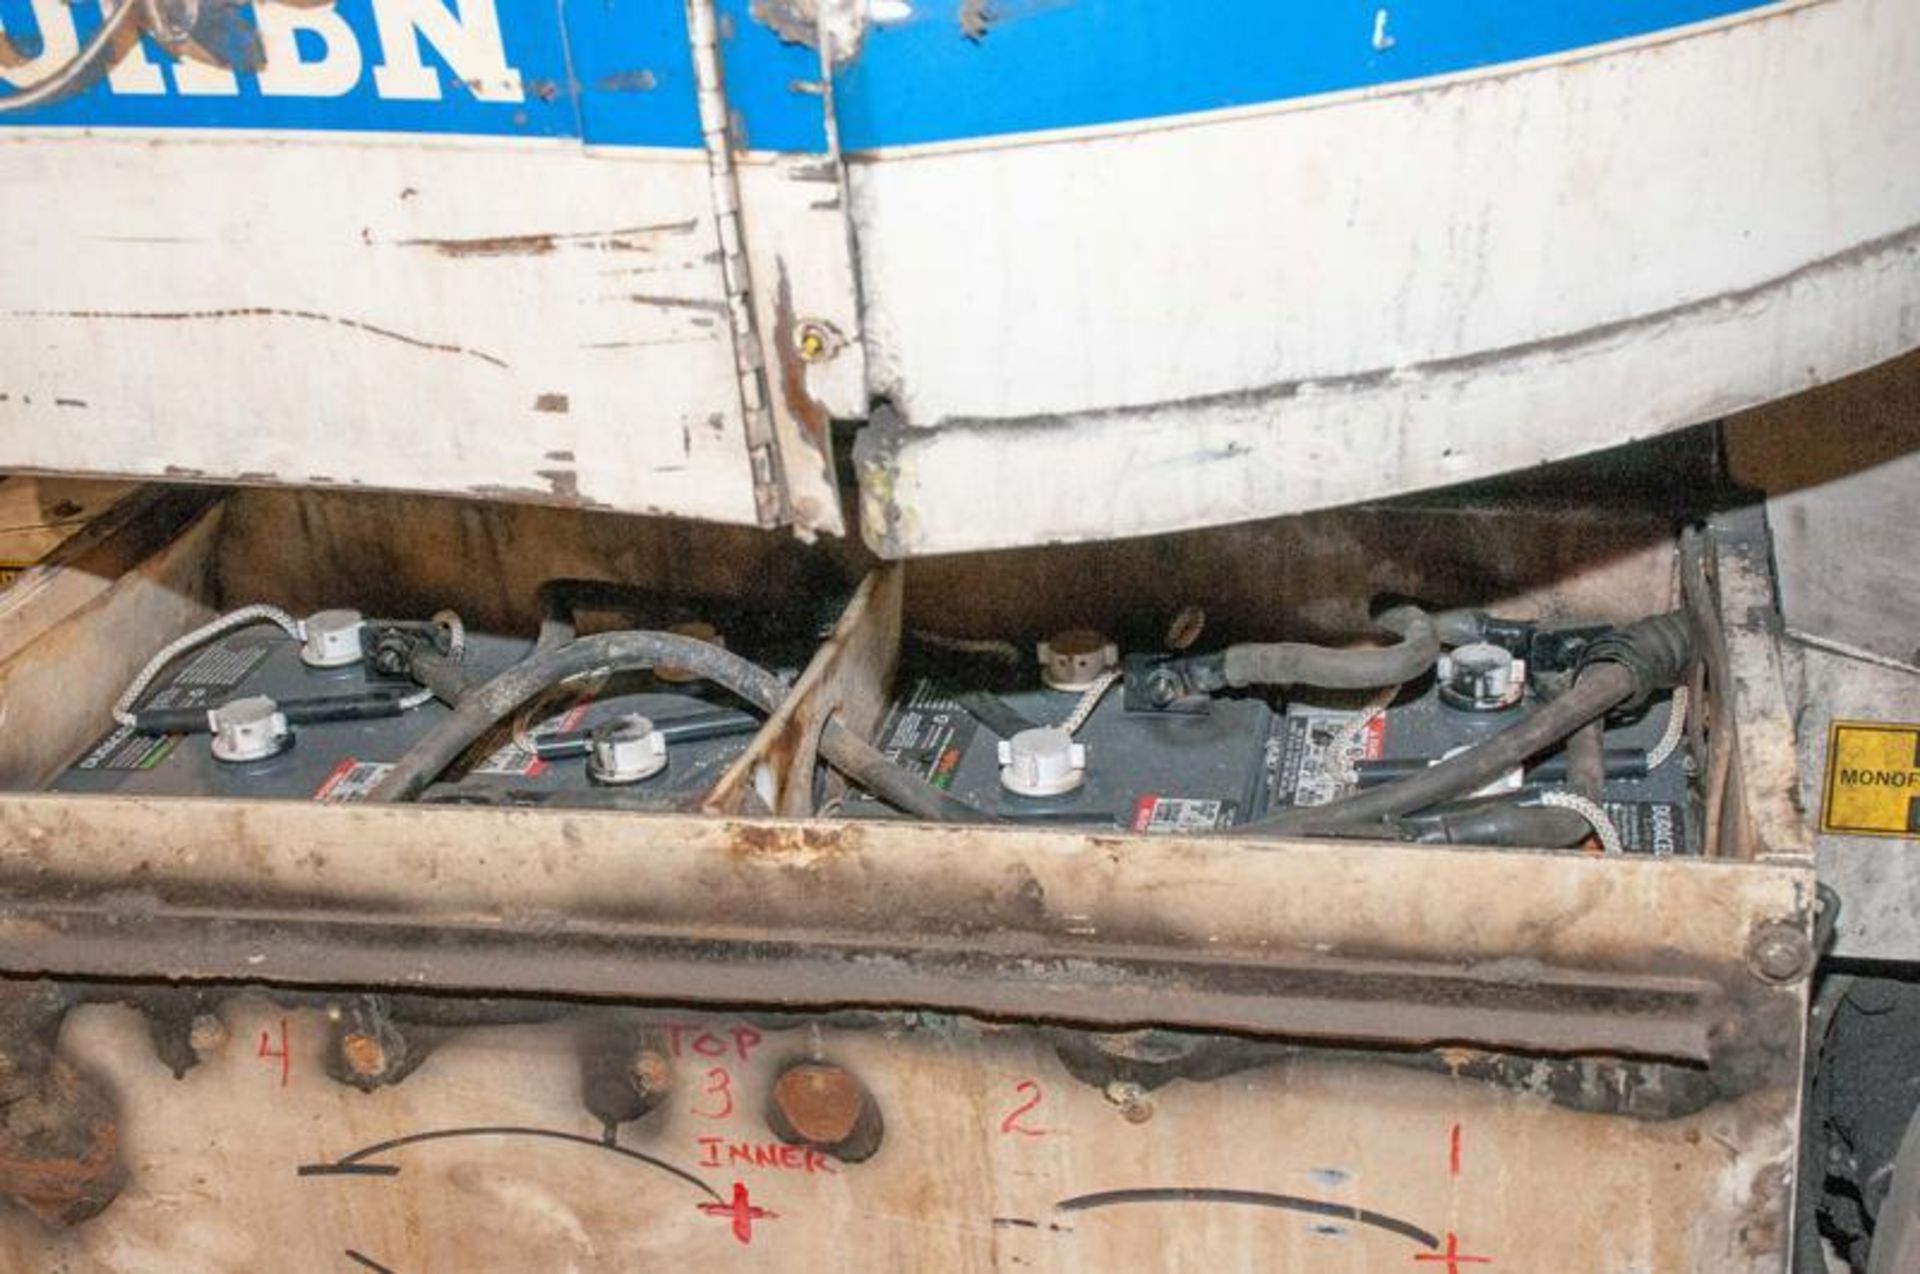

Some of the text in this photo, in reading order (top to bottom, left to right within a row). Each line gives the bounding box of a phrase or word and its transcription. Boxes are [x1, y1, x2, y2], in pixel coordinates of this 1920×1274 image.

[258, 1018, 289, 1087] 4
[655, 1022, 762, 1061] TOP
[689, 1067, 733, 1119] 3
[1002, 1080, 1052, 1136] 2
[698, 1136, 838, 1175] INNER
